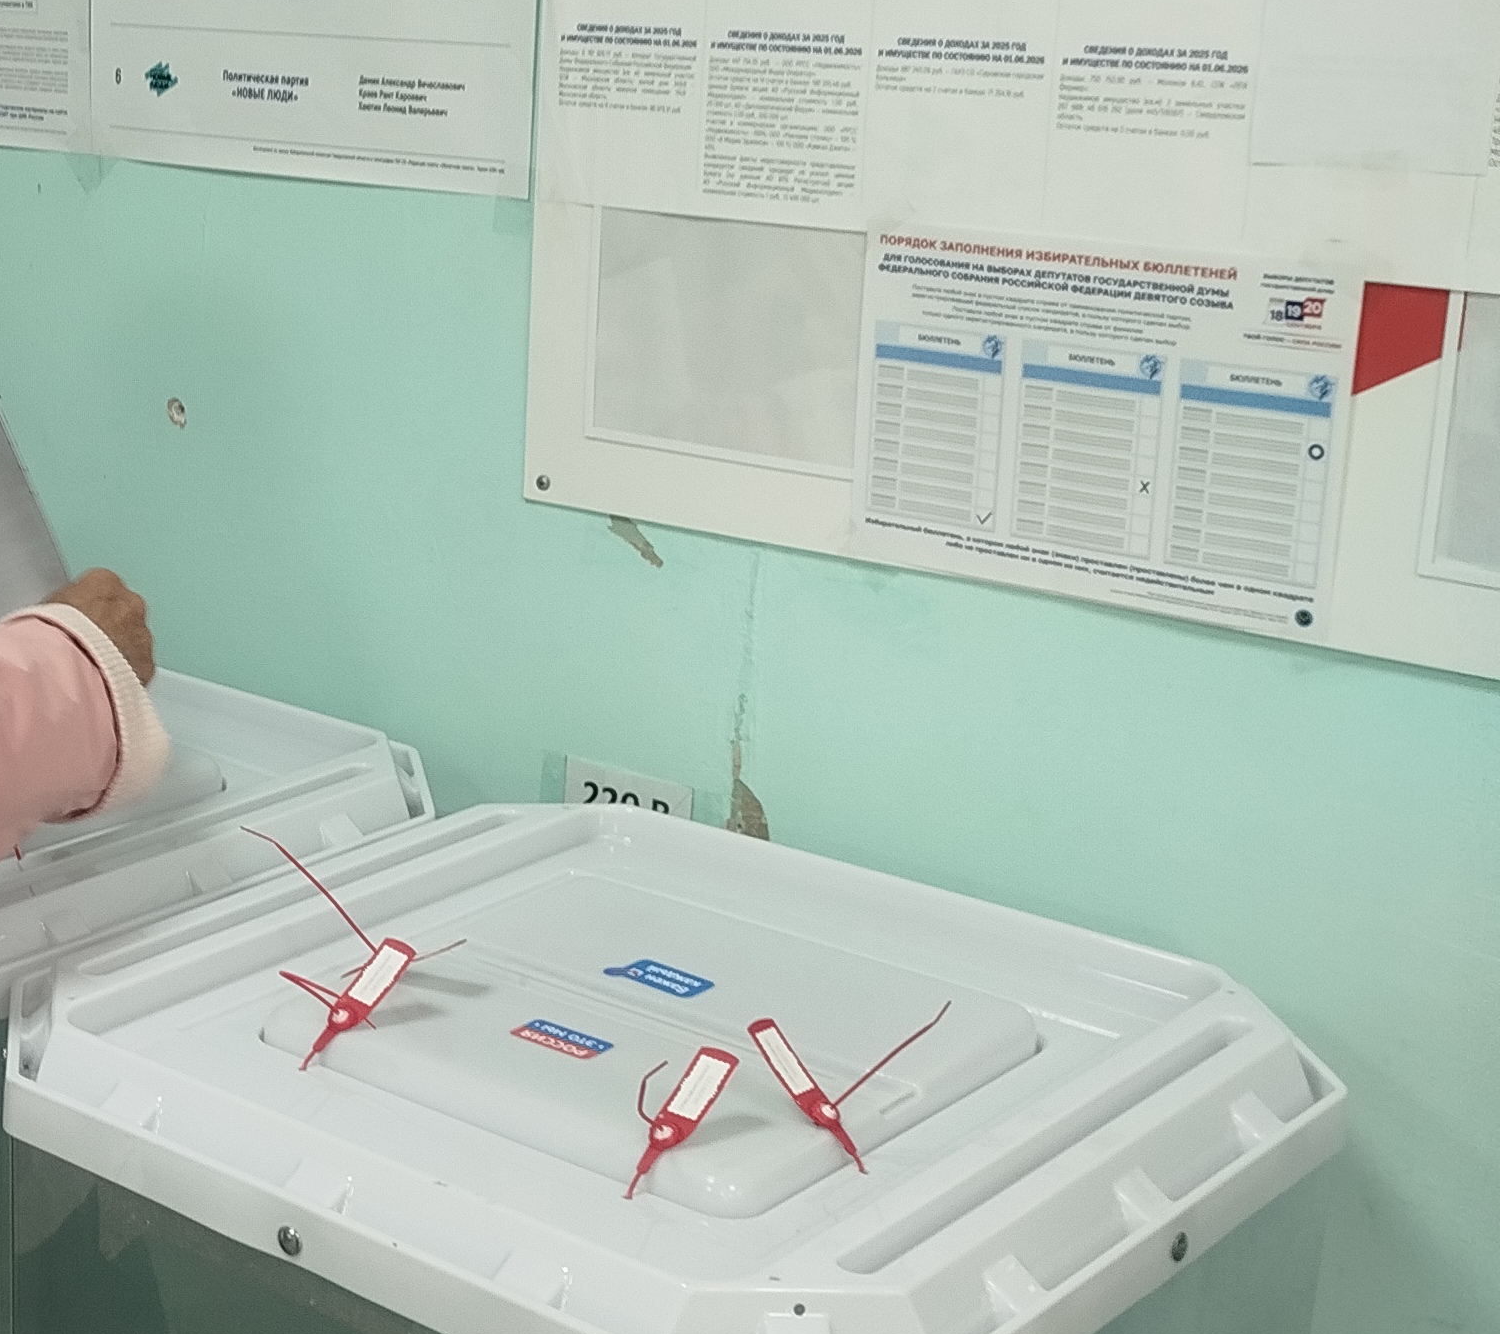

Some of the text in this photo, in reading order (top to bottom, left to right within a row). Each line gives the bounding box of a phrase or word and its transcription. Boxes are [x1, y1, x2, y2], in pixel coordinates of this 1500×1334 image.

[115, 67, 122, 84] 6
[222, 70, 279, 84] Политическая
[880, 234, 1237, 280] ПОРЯДОК ЗАПОЛНЕНИЯ ИЗБИРАТЕЛЬНЫХ БЮЛЛЕТЕНЕЙ
[878, 264, 1234, 310] ФЕДЕРАЛЬНОГО СОБРАНИЯ РОССИЙСКОЙ ФЕДЕРАЦИИ ДЕВЯТОГО СОЗЫВА
[883, 253, 1230, 298] ДЛЯ ГОЛОСОВАНИЯ НА ВЫБОРАХ ДЕПУТАТОВ ГОСУДАРСТВЕННОЙ ДУМЫ
[1304, 302, 1322, 314] 20
